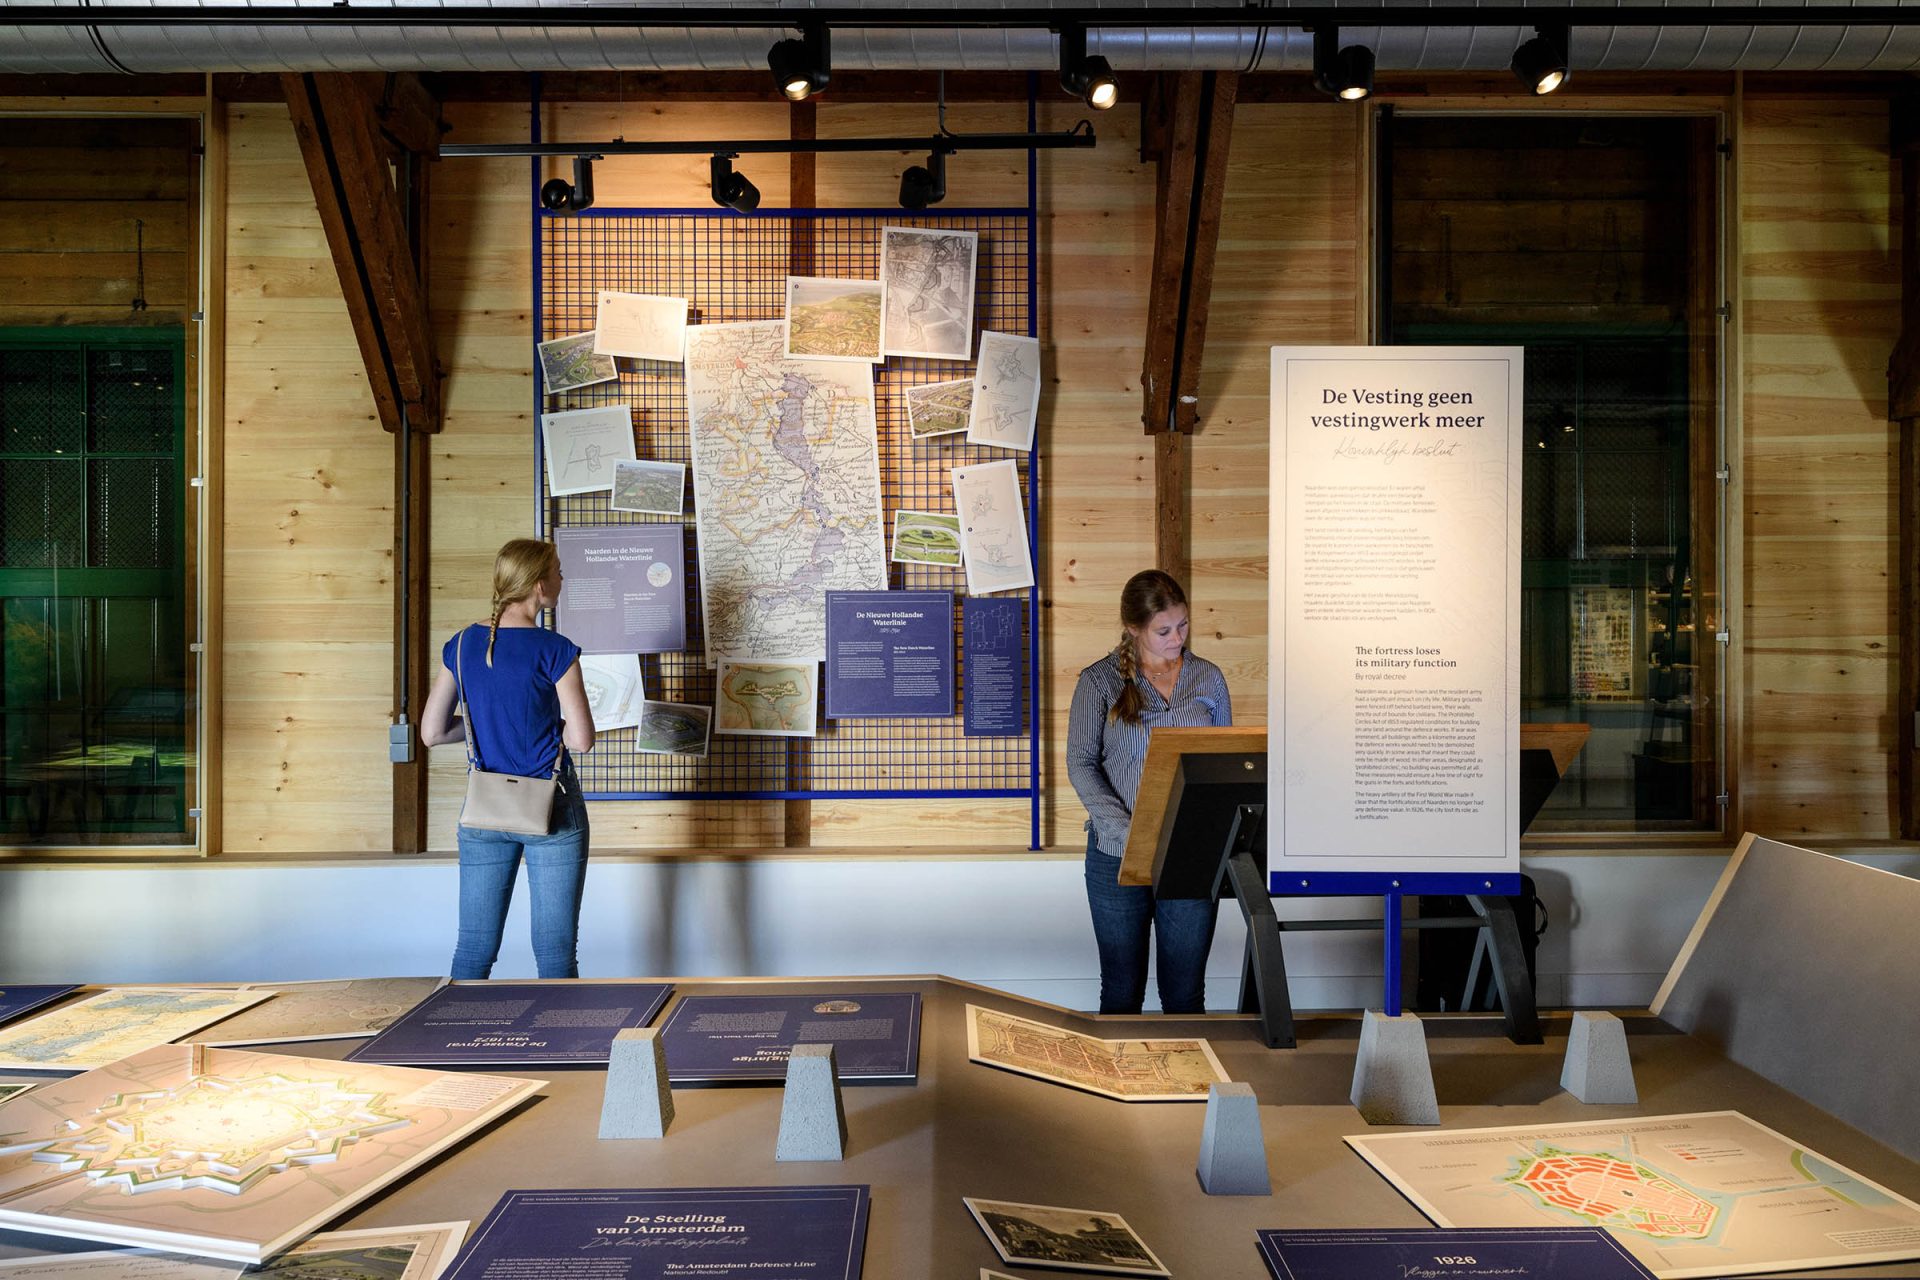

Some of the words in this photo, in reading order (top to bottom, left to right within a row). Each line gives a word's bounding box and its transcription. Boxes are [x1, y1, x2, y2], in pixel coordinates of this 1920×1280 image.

[1322, 389, 1347, 404] De
[1352, 388, 1423, 407] Vesting
[1428, 392, 1473, 407] geen
[1312, 412, 1430, 430] vestingwerk
[1436, 416, 1485, 428] meer
[1412, 439, 1462, 456] besluit
[1356, 646, 1373, 655] The
[1375, 646, 1414, 655] fortress
[1416, 646, 1440, 655] loses
[1356, 658, 1368, 667] its
[1370, 658, 1410, 669] military
[1414, 658, 1456, 667] function
[624, 1215, 650, 1224] De
[654, 1214, 727, 1225] Stelling
[634, 1224, 745, 1234] Amsterdam
[1433, 1256, 1478, 1265] 1926
[1397, 1264, 1449, 1279] Vlaggen
